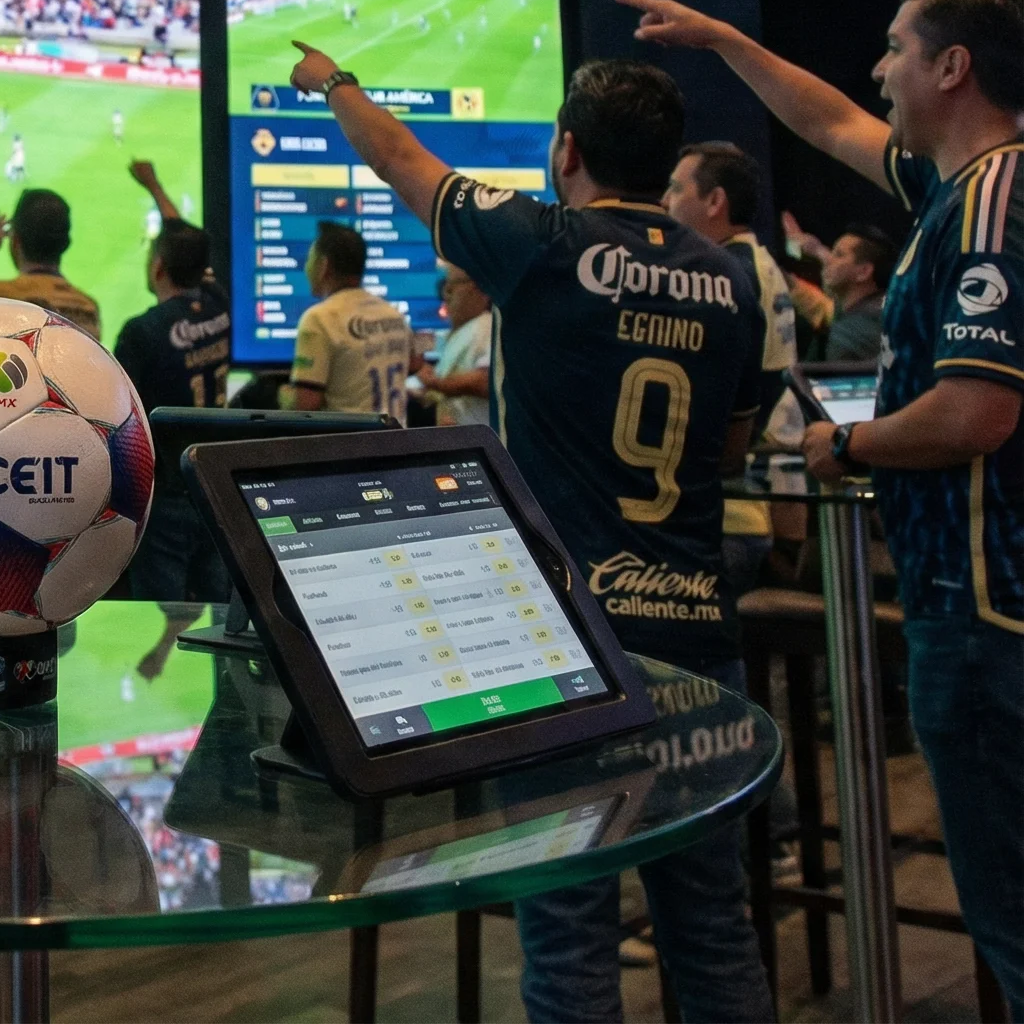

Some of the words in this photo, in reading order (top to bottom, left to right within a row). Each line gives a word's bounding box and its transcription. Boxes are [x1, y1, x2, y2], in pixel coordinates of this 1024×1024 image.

[577, 242, 739, 314] Corona
[943, 323, 1016, 347] TOTAL
[612, 357, 692, 523] 9
